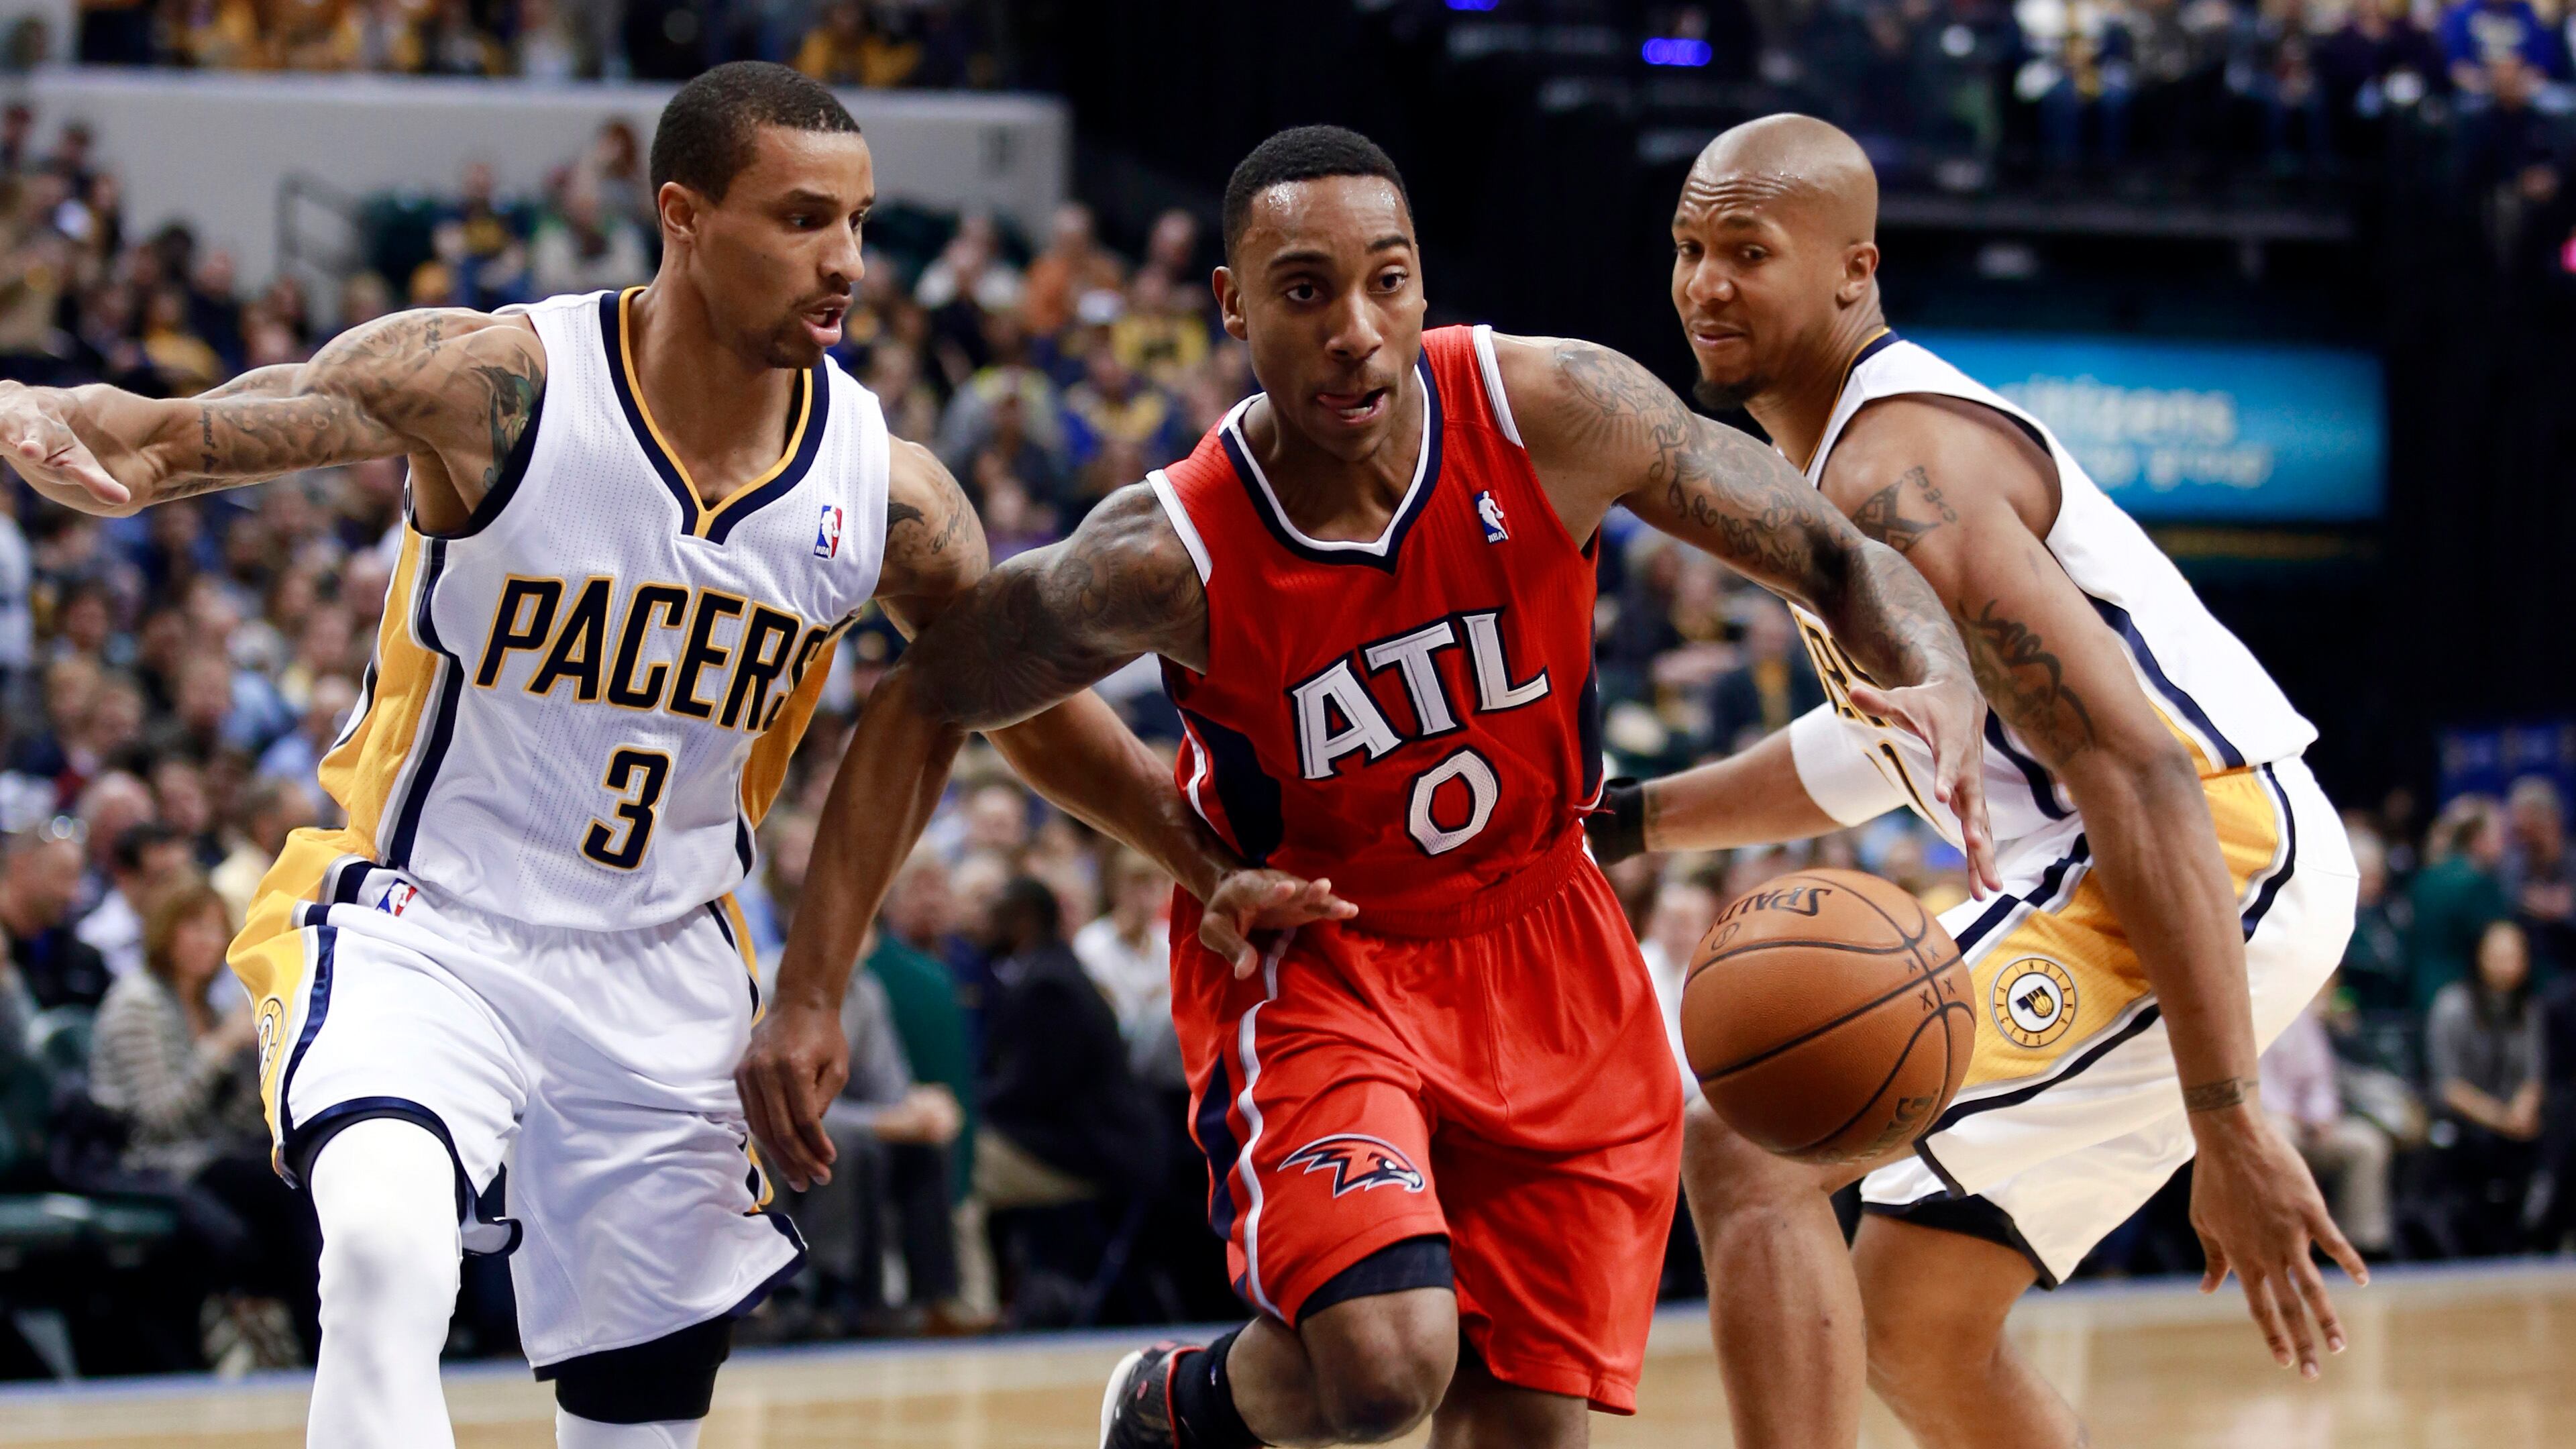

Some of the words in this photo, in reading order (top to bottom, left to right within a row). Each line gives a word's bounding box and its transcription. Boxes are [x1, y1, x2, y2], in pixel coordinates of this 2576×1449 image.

[1487, 531, 1505, 543] NBA
[1287, 609, 1552, 781] ATL
[580, 745, 672, 871] 3
[1407, 747, 1501, 856] 0
